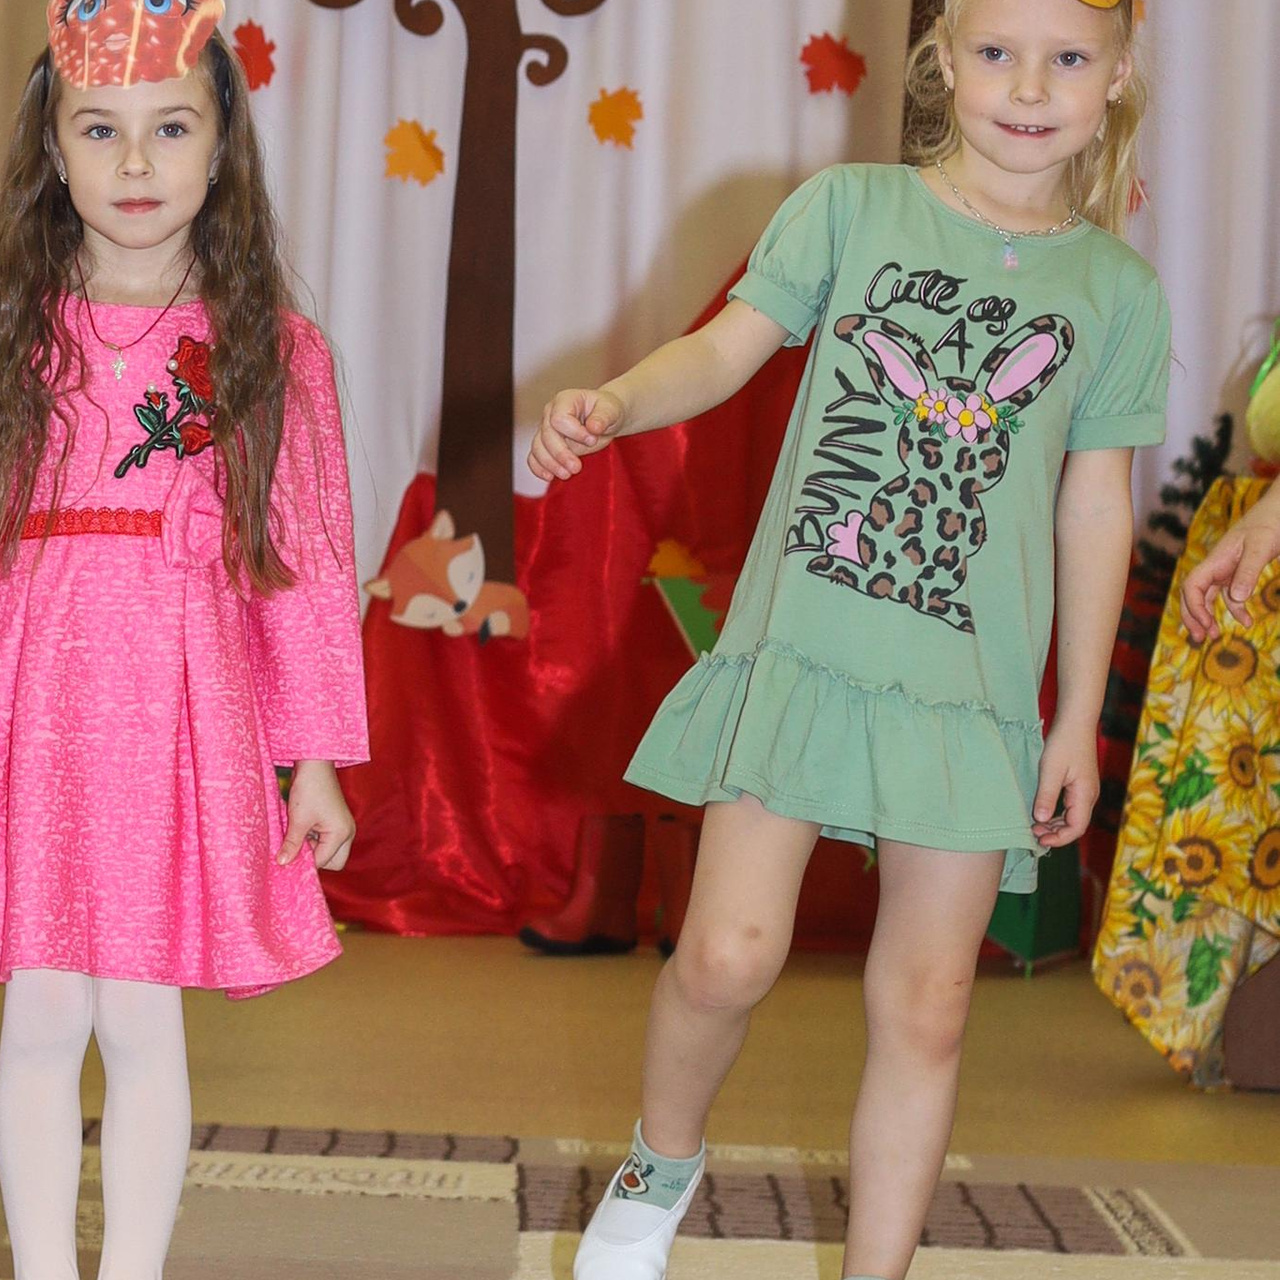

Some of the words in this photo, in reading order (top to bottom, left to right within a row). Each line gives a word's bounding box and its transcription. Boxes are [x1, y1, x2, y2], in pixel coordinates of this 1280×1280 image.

[864, 261, 969, 315] Cute
[966, 295, 1017, 336] as
[931, 317, 974, 373] A
[784, 366, 887, 557] BUNNY
